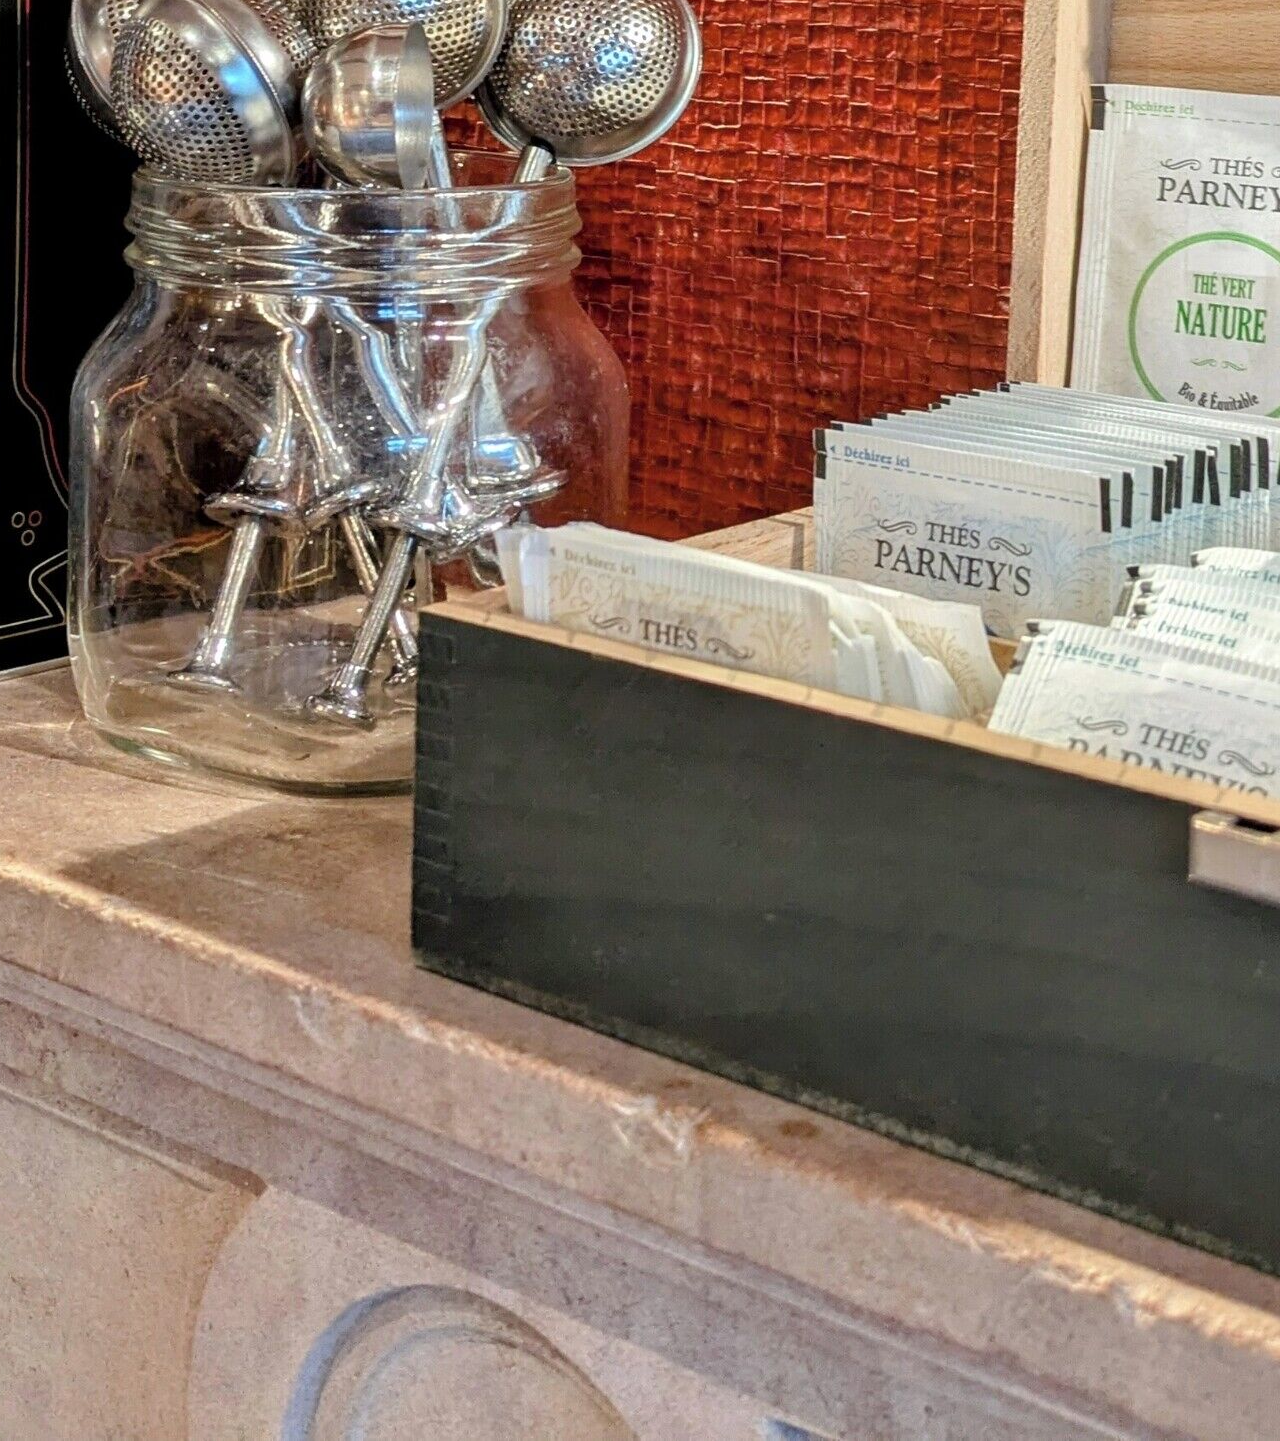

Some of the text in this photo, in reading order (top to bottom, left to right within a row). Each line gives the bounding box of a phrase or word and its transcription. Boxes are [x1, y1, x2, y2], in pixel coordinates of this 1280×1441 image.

[1210, 157, 1265, 178] THÉS
[1193, 272, 1256, 300] THÉ VERT
[1175, 300, 1267, 344] NATURE
[1178, 382, 1196, 402] Bio
[1198, 392, 1207, 407] &
[895, 456, 910, 468] ici
[925, 521, 981, 549] THÉS
[874, 538, 1031, 596] PARNEY'S
[639, 618, 697, 651] THÉS
[1118, 654, 1140, 668] ici
[1140, 722, 1210, 760] THÉS
